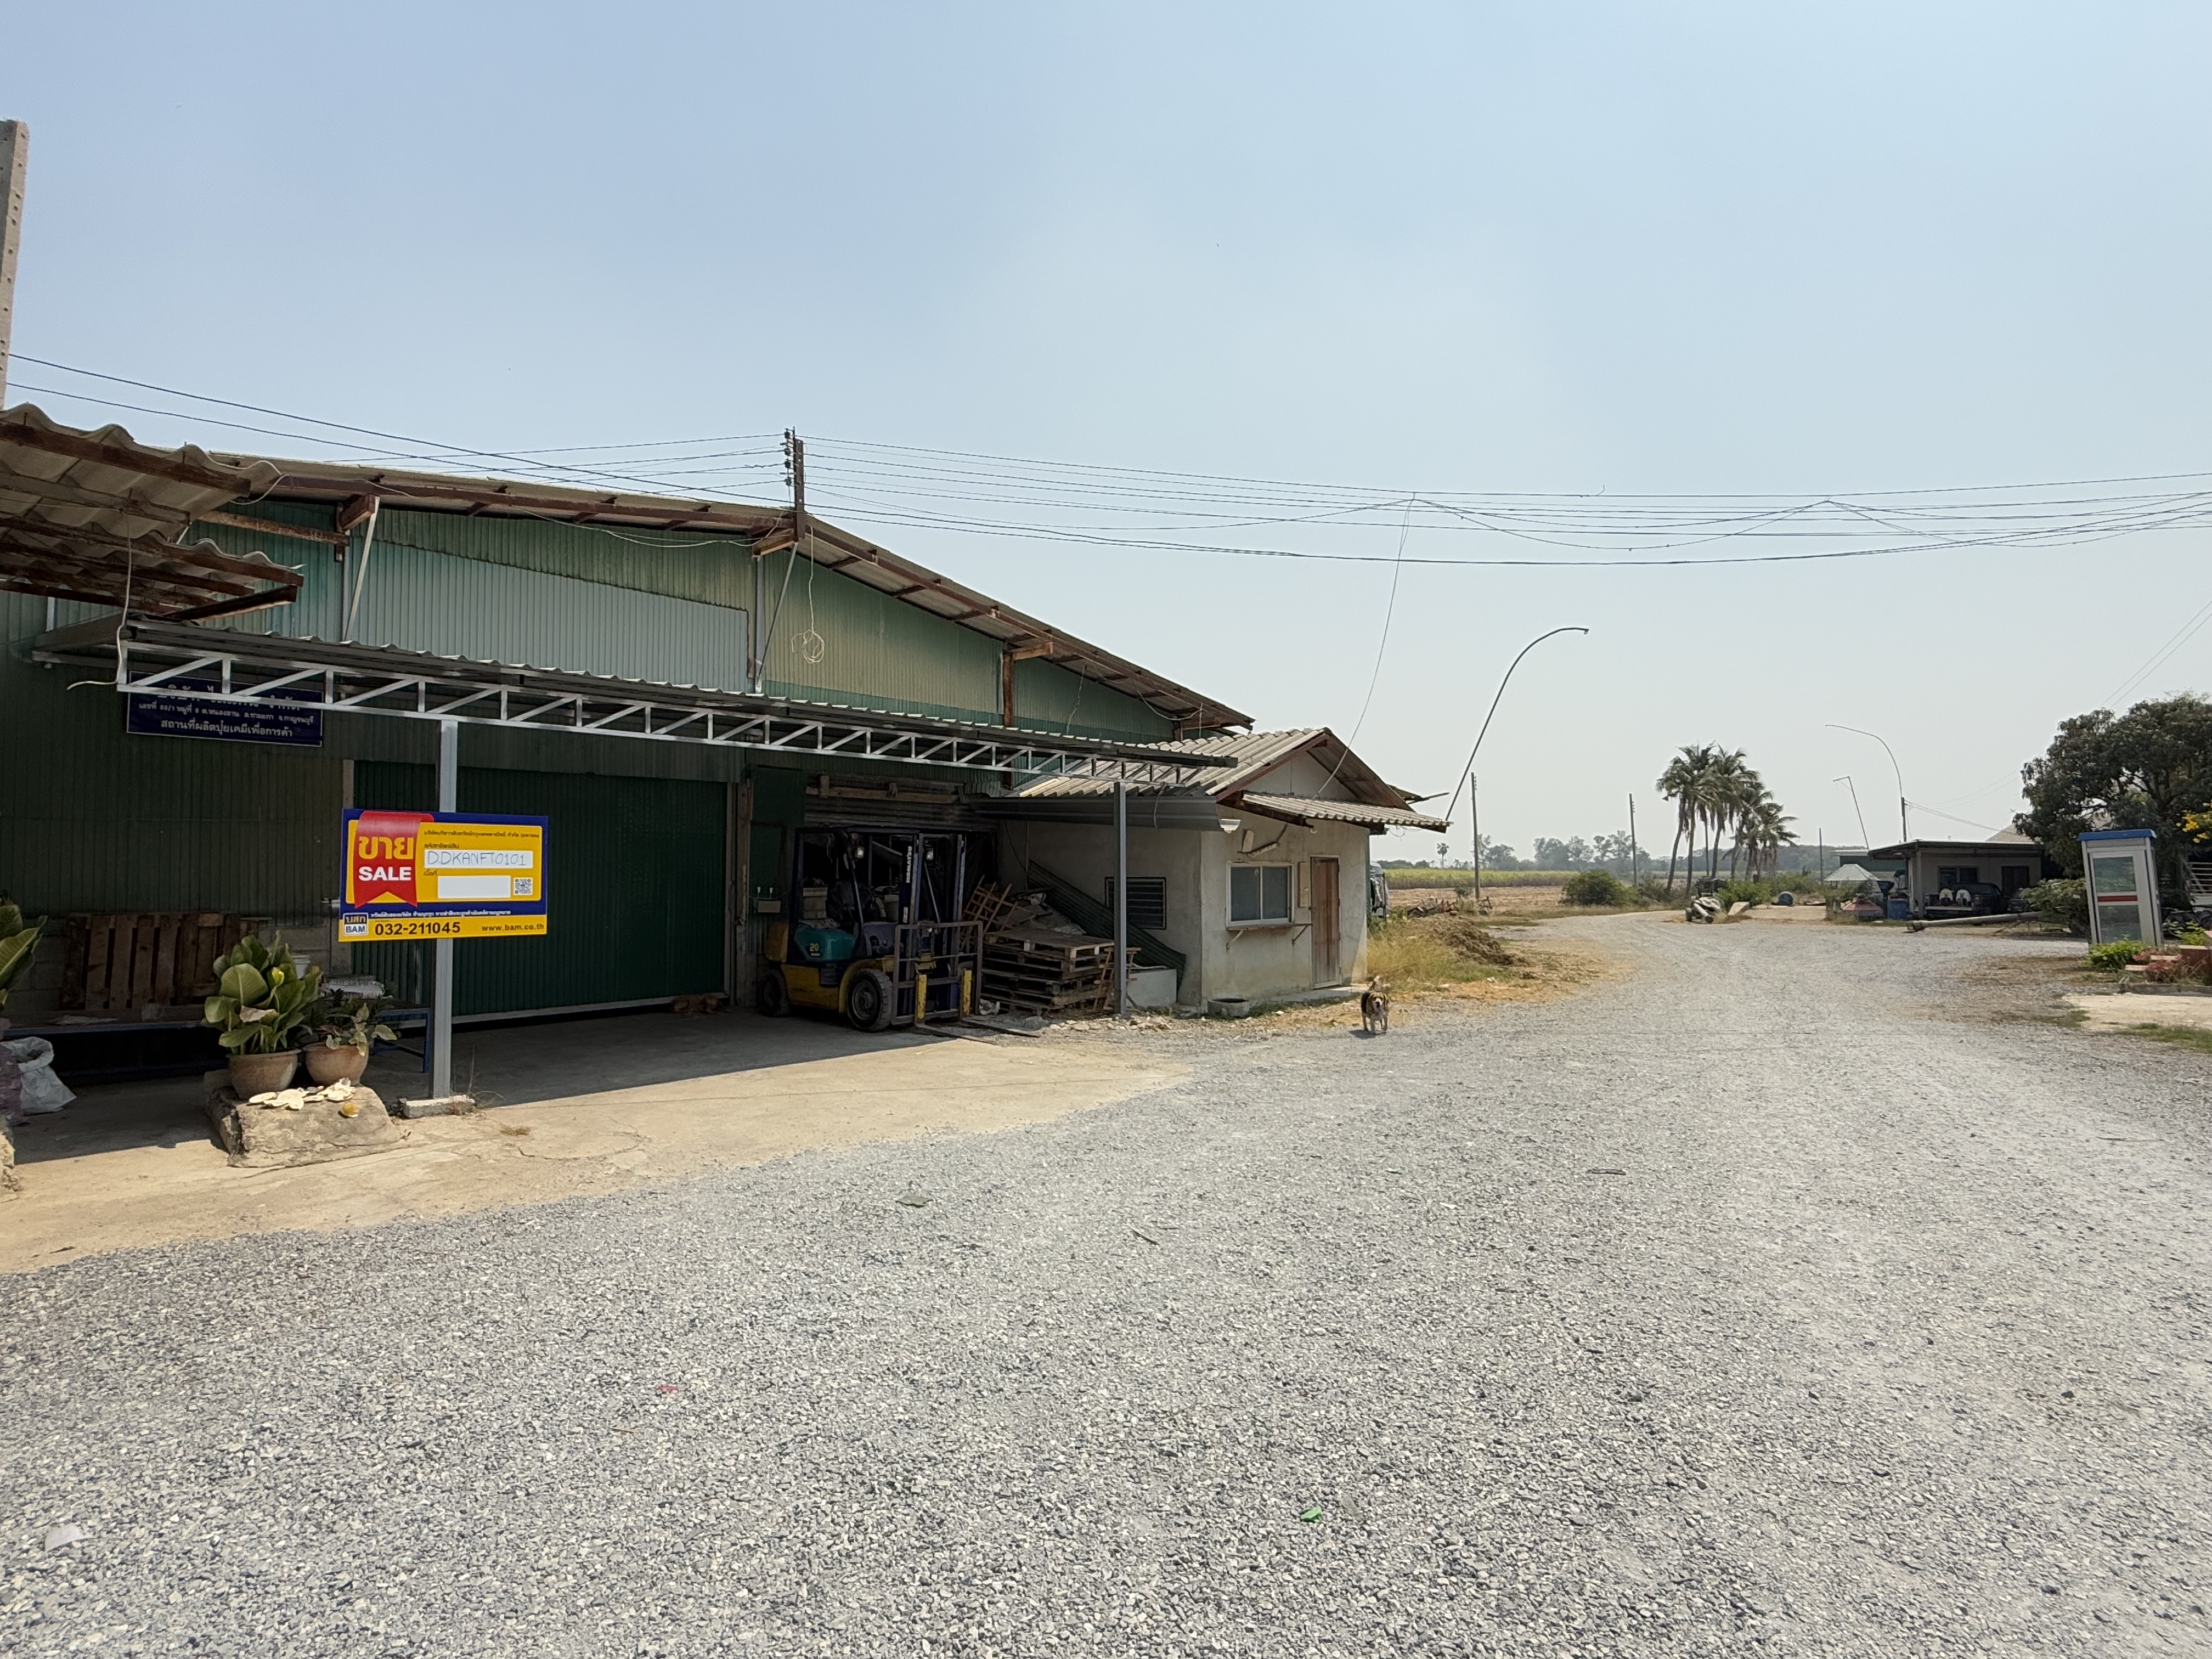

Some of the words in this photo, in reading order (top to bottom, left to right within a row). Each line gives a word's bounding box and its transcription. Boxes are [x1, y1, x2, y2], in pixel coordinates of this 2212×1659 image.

[161, 717, 293, 737] สถานที่ผลิตปุ๋ยเคมีเพื่อการค้า
[358, 836, 413, 860] ขาย
[359, 867, 411, 881] SALE
[345, 915, 366, 923] บสก
[346, 925, 366, 934] BAM
[375, 922, 460, 936] 032-211045
[482, 923, 544, 932] www.bam.co.th
[809, 943, 820, 952] 20
